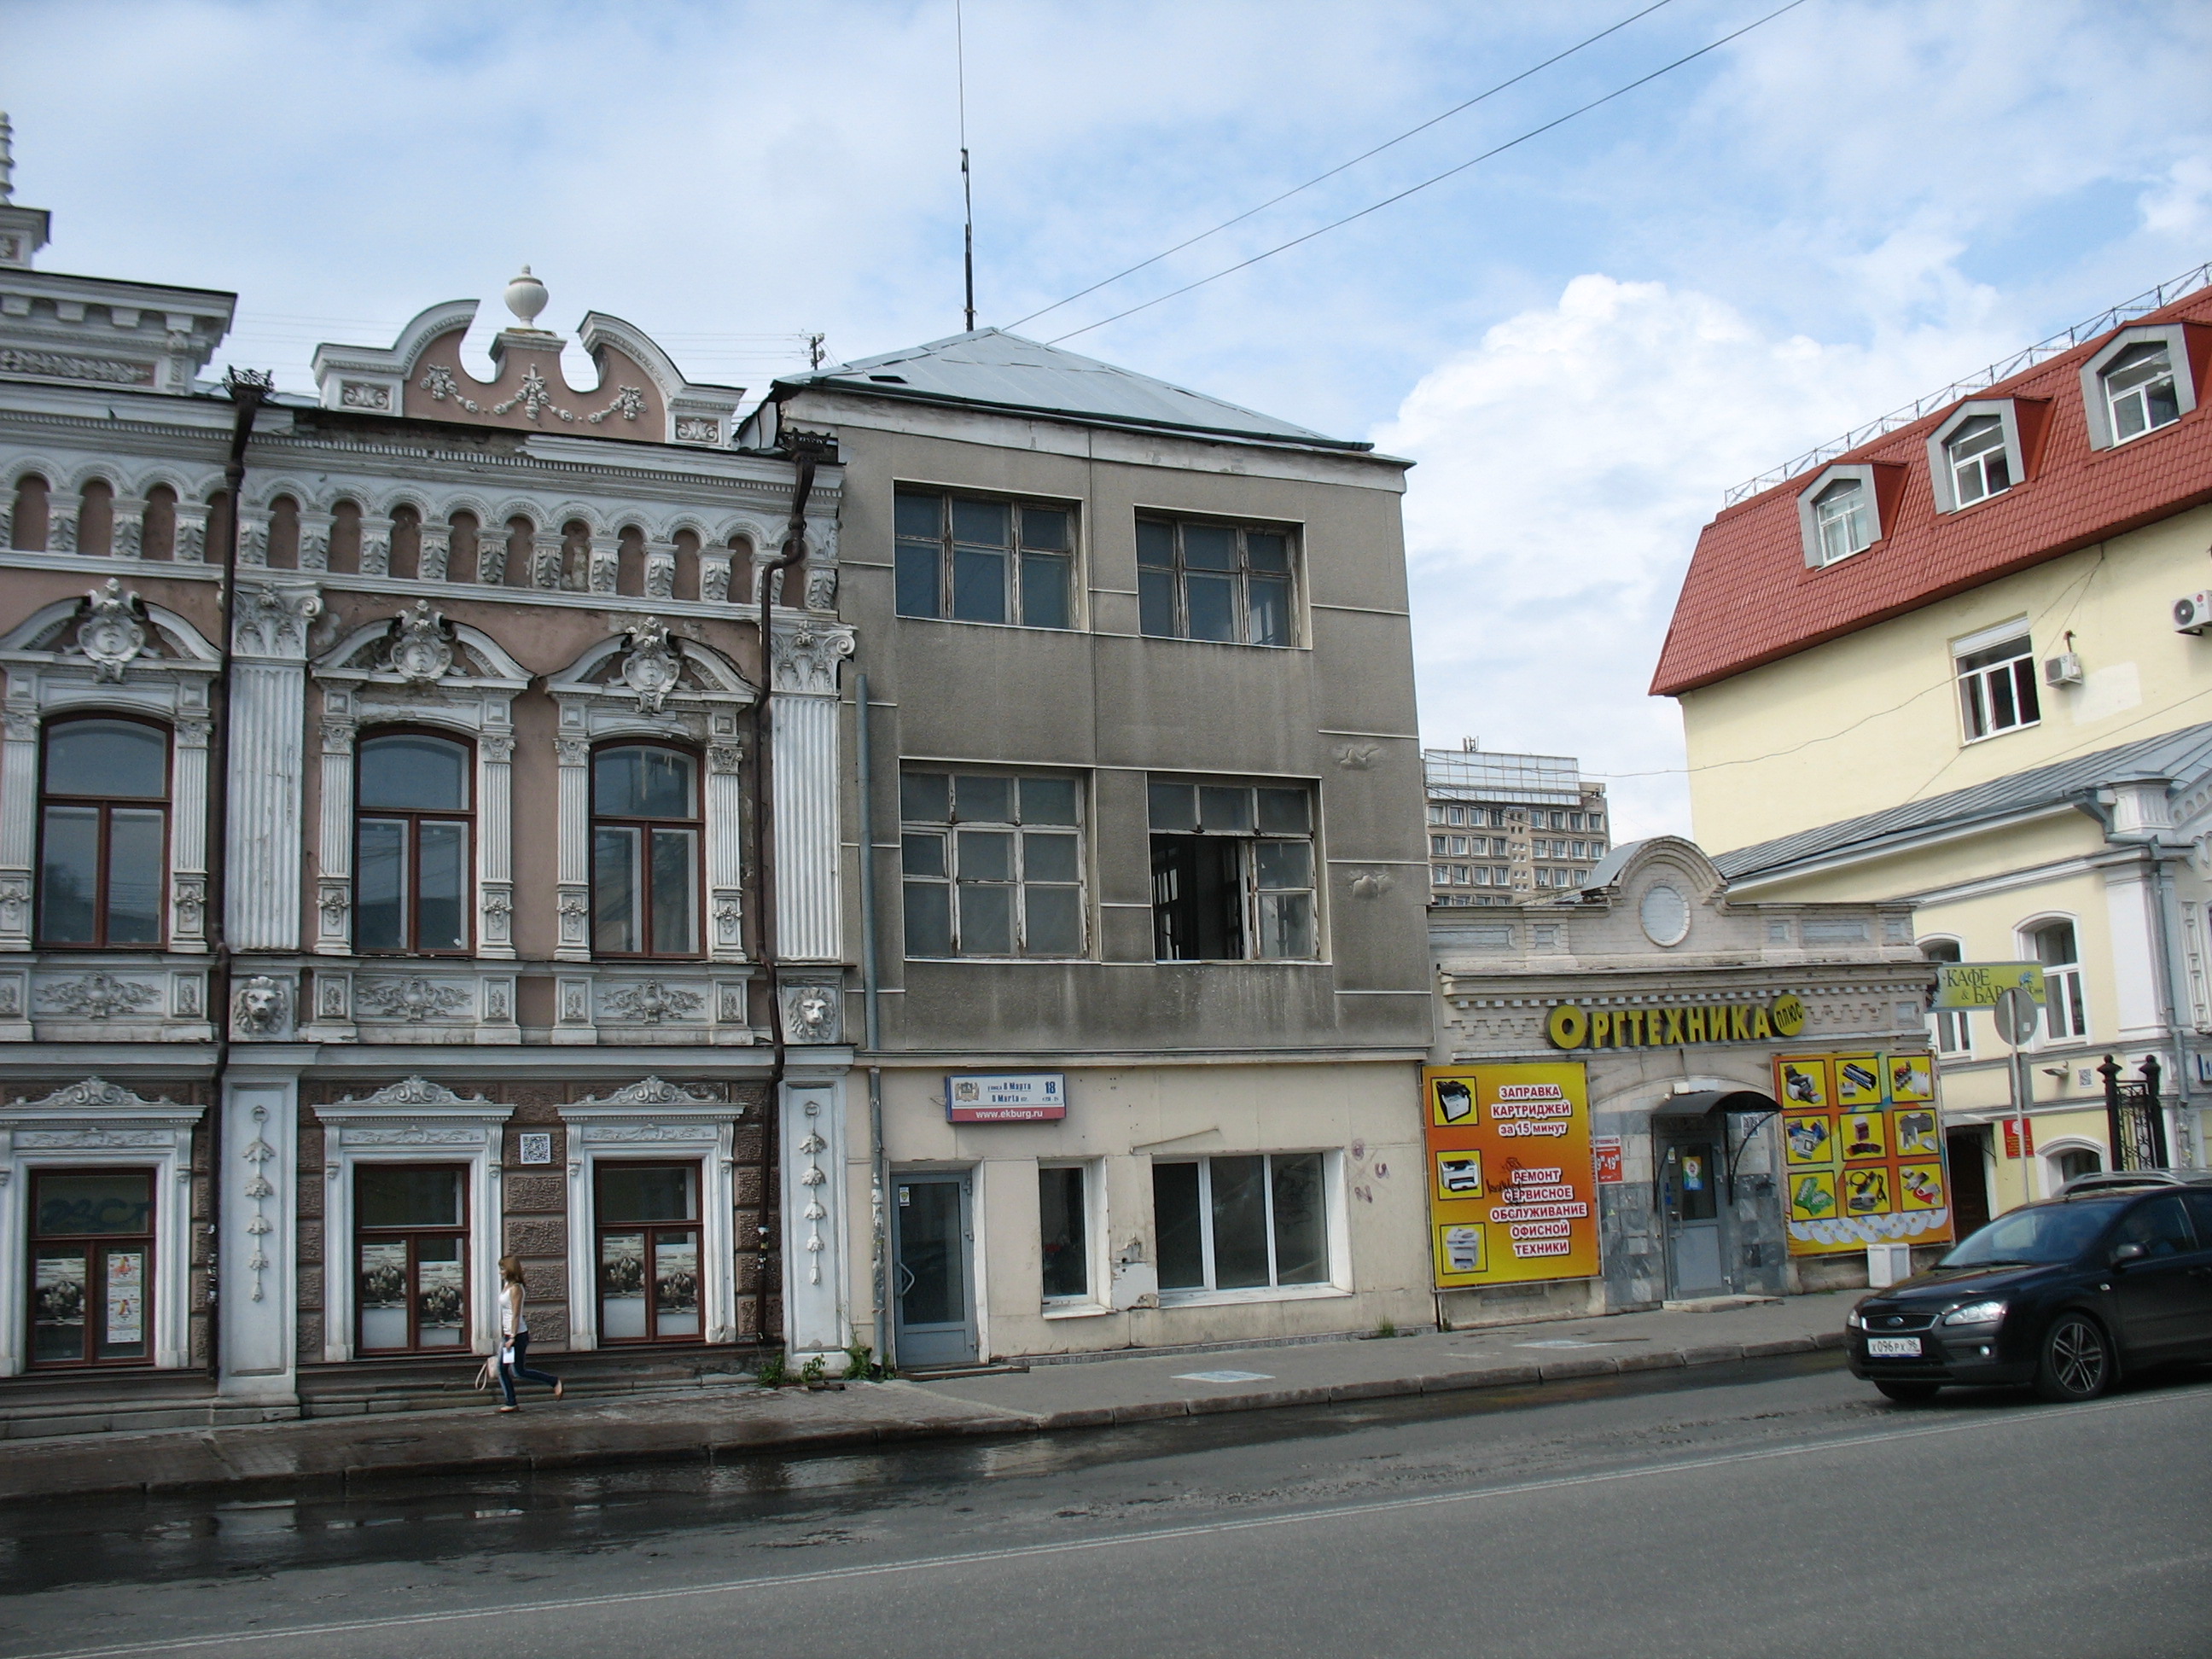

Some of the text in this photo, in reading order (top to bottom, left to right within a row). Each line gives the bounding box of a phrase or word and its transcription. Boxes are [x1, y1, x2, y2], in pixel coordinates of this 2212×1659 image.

[1946, 968, 1990, 987] КАФЕ
[1547, 1003, 1773, 1050] ОРГТЕХНИКА
[1010, 1082, 1031, 1091] Марта
[1045, 1080, 1057, 1094] 18
[1500, 1086, 1560, 1098] ЗАПРАВКА
[975, 1109, 1043, 1119] www.ekburg.ru
[1493, 1102, 1570, 1116] КАРТРИДЖЕЙ
[1500, 1123, 1566, 1135] за 15 минут
[1514, 1170, 1560, 1183] РЕМОНТ
[1504, 1187, 1572, 1202] СЕРВИСНОЕ
[1492, 1204, 1586, 1220] ОБСЛУЖИВАНИЕ
[1512, 1221, 1569, 1237] ОФИСНОЙ
[1515, 1242, 1568, 1255] ТЕХНИКИ
